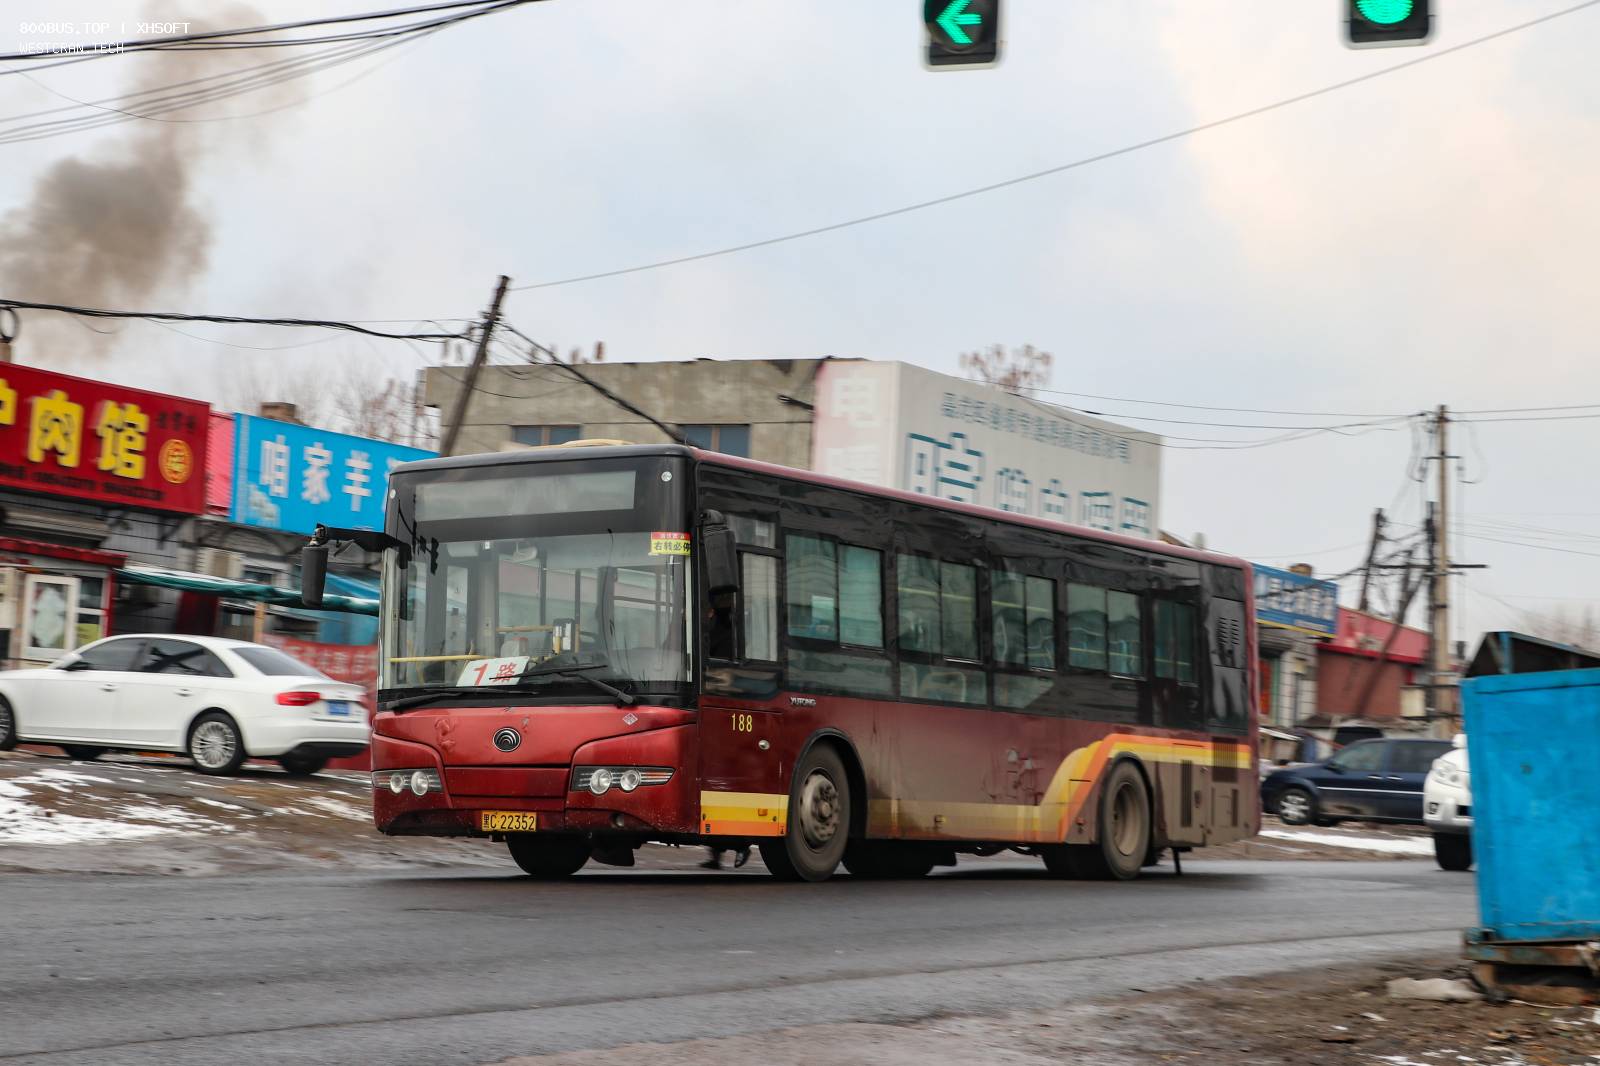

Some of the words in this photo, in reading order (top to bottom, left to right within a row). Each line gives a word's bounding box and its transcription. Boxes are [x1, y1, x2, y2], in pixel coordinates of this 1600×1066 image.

[259, 434, 405, 513] 咱家羊
[731, 713, 753, 733] 188
